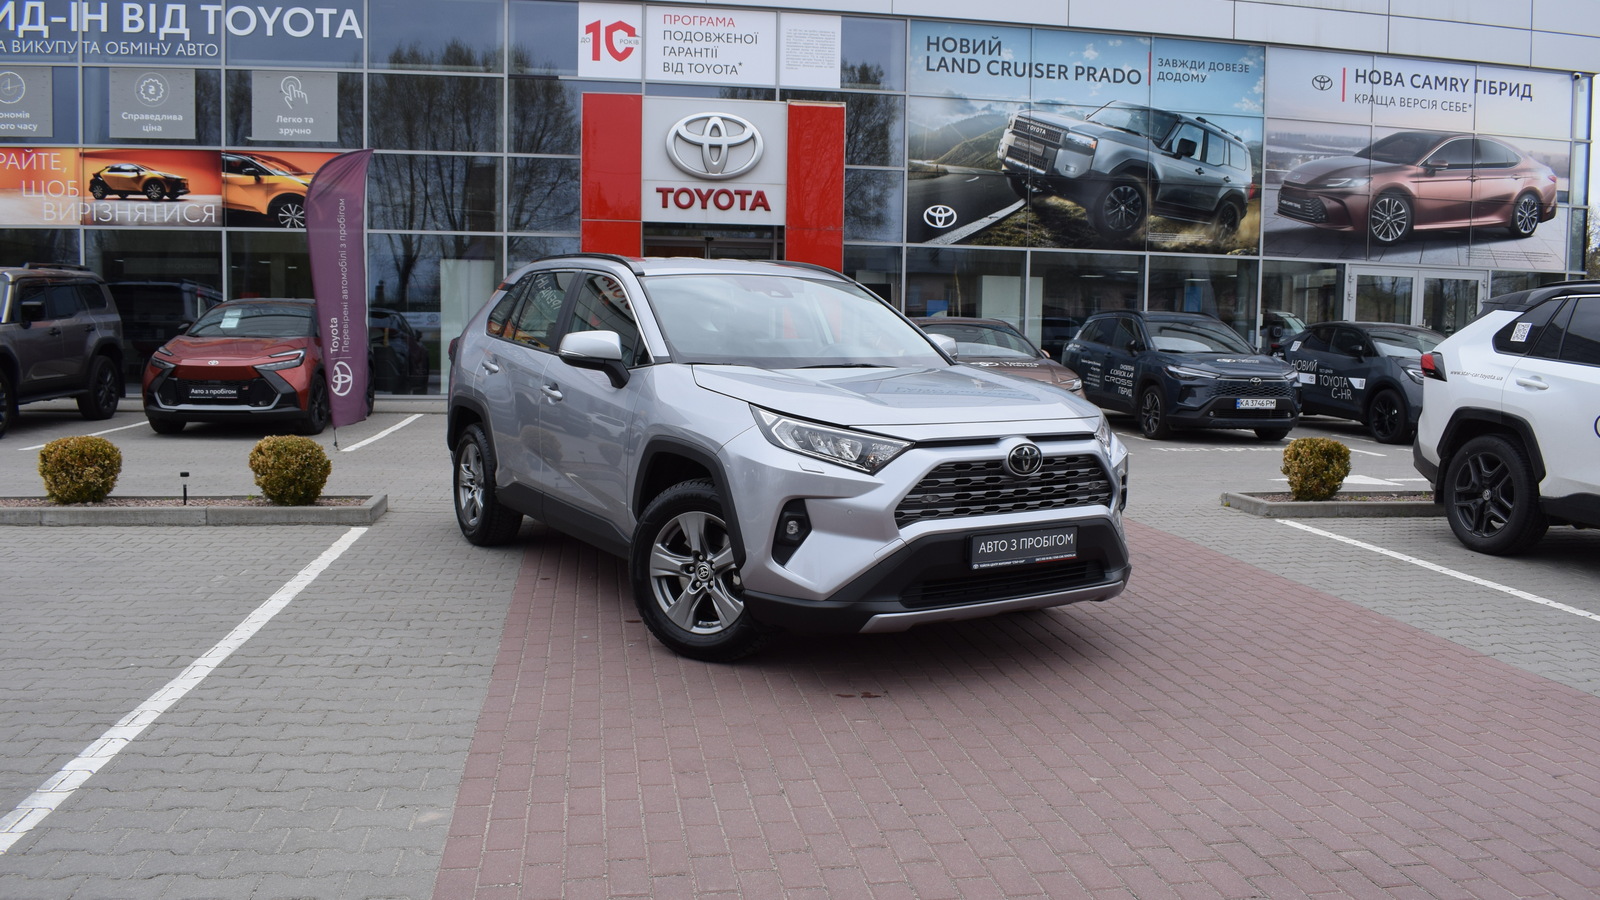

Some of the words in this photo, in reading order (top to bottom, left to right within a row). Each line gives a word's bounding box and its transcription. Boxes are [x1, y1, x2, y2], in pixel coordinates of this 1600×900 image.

[122, 3, 190, 41] ВІД
[200, 5, 363, 39] TOYOTA
[663, 14, 736, 28] ПРОГРАМА
[663, 30, 759, 45] ПОДОВЖЕНОЇ
[12, 40, 78, 54] ВИКУПУ
[82, 41, 100, 54] ТА
[105, 41, 171, 56] ОБМІНУ
[175, 43, 218, 57] АВТО
[663, 45, 718, 60] ГАРАНТІЇ
[926, 36, 1002, 57] НОВИЙ
[663, 61, 684, 75] ВІД
[925, 55, 981, 75] LAND
[986, 60, 1069, 81] CRUISER
[1074, 66, 1142, 86] PRADO
[1157, 57, 1205, 71] ЗАВЖДИ
[1208, 60, 1250, 74] ДОВЕЗЕ
[1156, 71, 1207, 84] ДОДОМУ
[1355, 69, 1405, 88] НОВА
[1410, 73, 1470, 94] CAMRY
[1474, 79, 1533, 102] ГІБРИД
[1354, 93, 1396, 108] КРАЩА
[1399, 97, 1438, 111] ВЕРСІЯ
[121, 112, 183, 122] Справедлива
[276, 115, 299, 126] Легко
[300, 116, 313, 125] та
[17, 123, 38, 132] часу
[142, 123, 162, 133] ціна
[278, 126, 312, 136] зручно
[22, 180, 79, 201] ЩОБ
[655, 187, 771, 212] TOYOTA
[44, 203, 215, 223] ВИРІЗНЯТИСЯ
[337, 198, 347, 241] пробігом
[338, 250, 349, 300] автомобілі
[330, 317, 340, 354] Toyota
[341, 302, 350, 353] Перевірені
[1291, 360, 1318, 372] НОВИЙ
[1104, 375, 1133, 387] CROSS
[1319, 375, 1349, 388] TOYOTA
[1331, 388, 1352, 400] C-HR
[978, 540, 1008, 554] АВТО
[1010, 539, 1017, 551] З
[1020, 533, 1074, 550] ПРОБІГОМ
